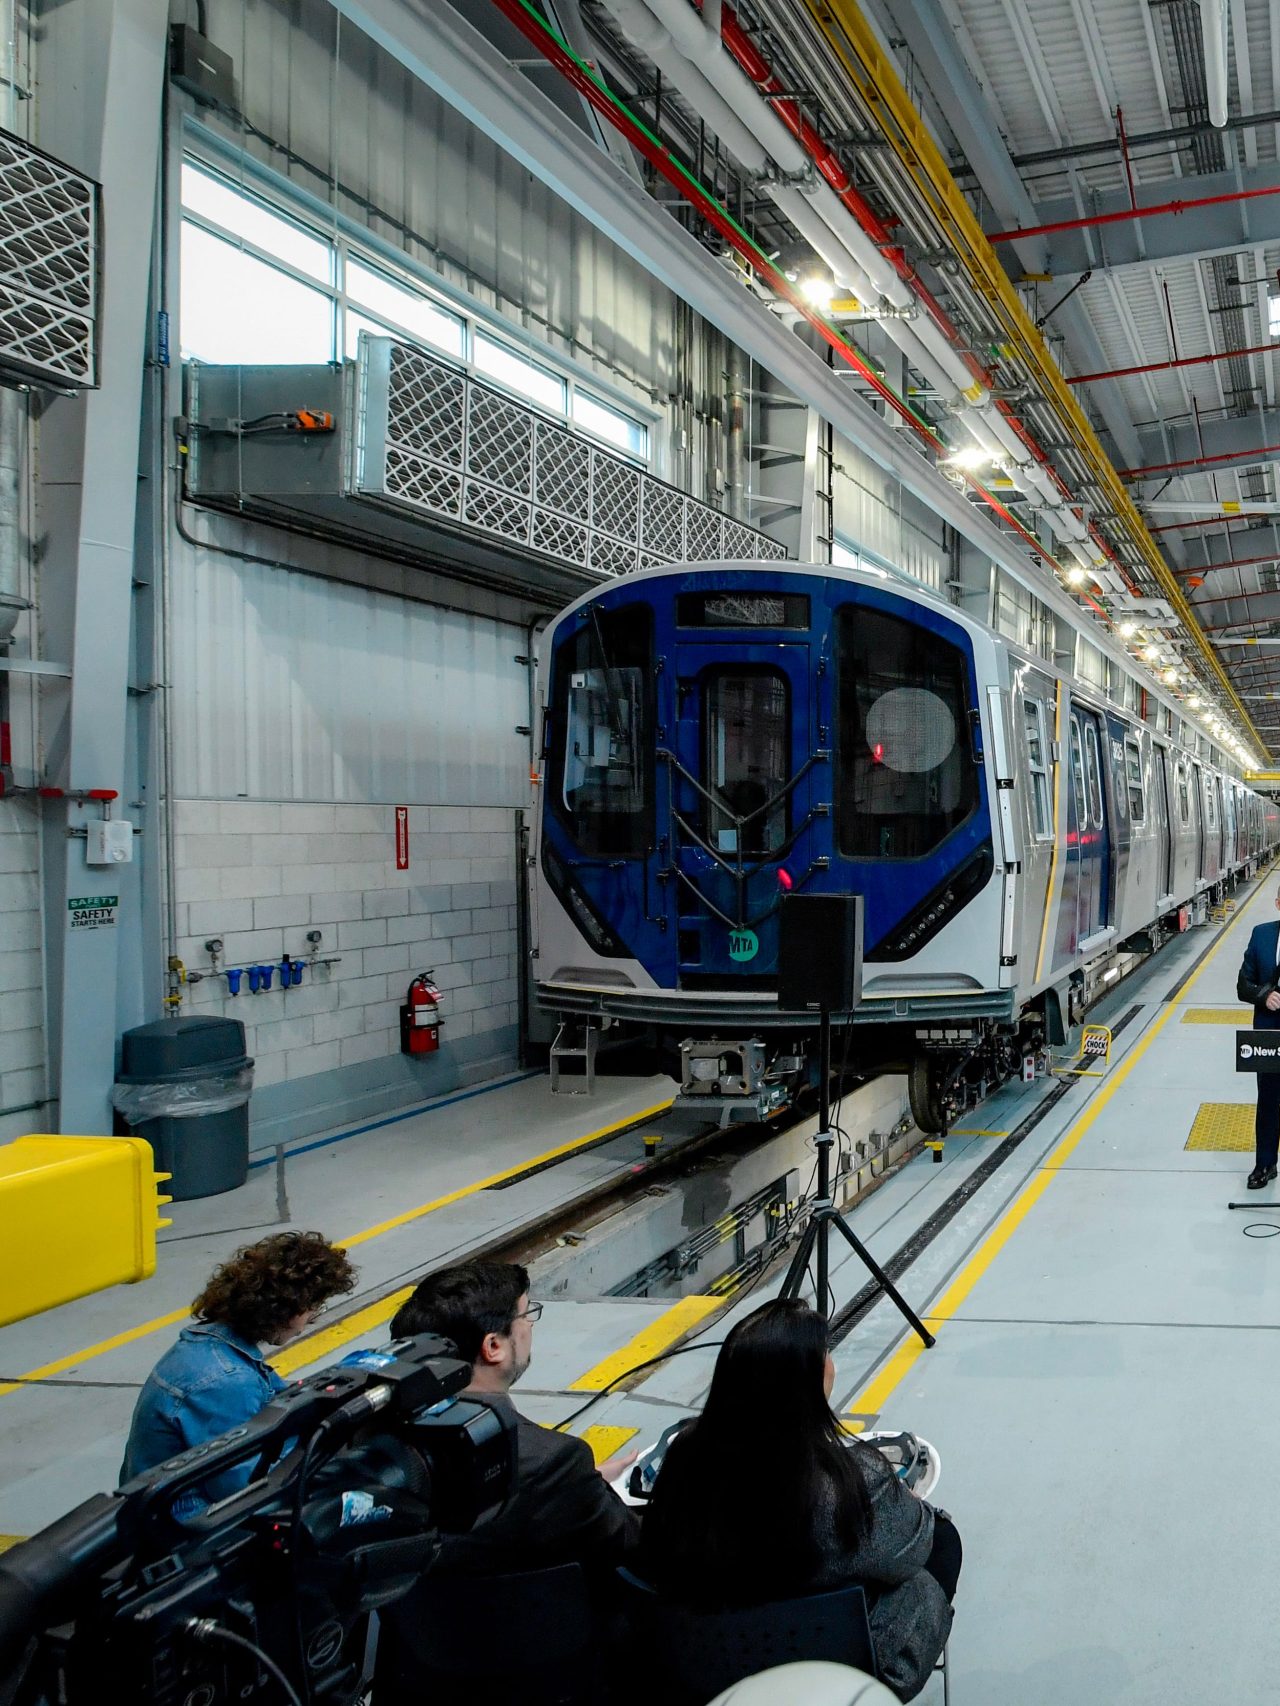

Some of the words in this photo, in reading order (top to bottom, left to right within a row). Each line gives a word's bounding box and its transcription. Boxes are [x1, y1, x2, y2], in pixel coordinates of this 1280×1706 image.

[70, 897, 115, 908] SAFETY
[73, 908, 113, 920] SAFETY
[71, 919, 97, 928] STARTS
[1086, 1040, 1105, 1049] CHOCK
[1253, 1046, 1276, 1056] New
